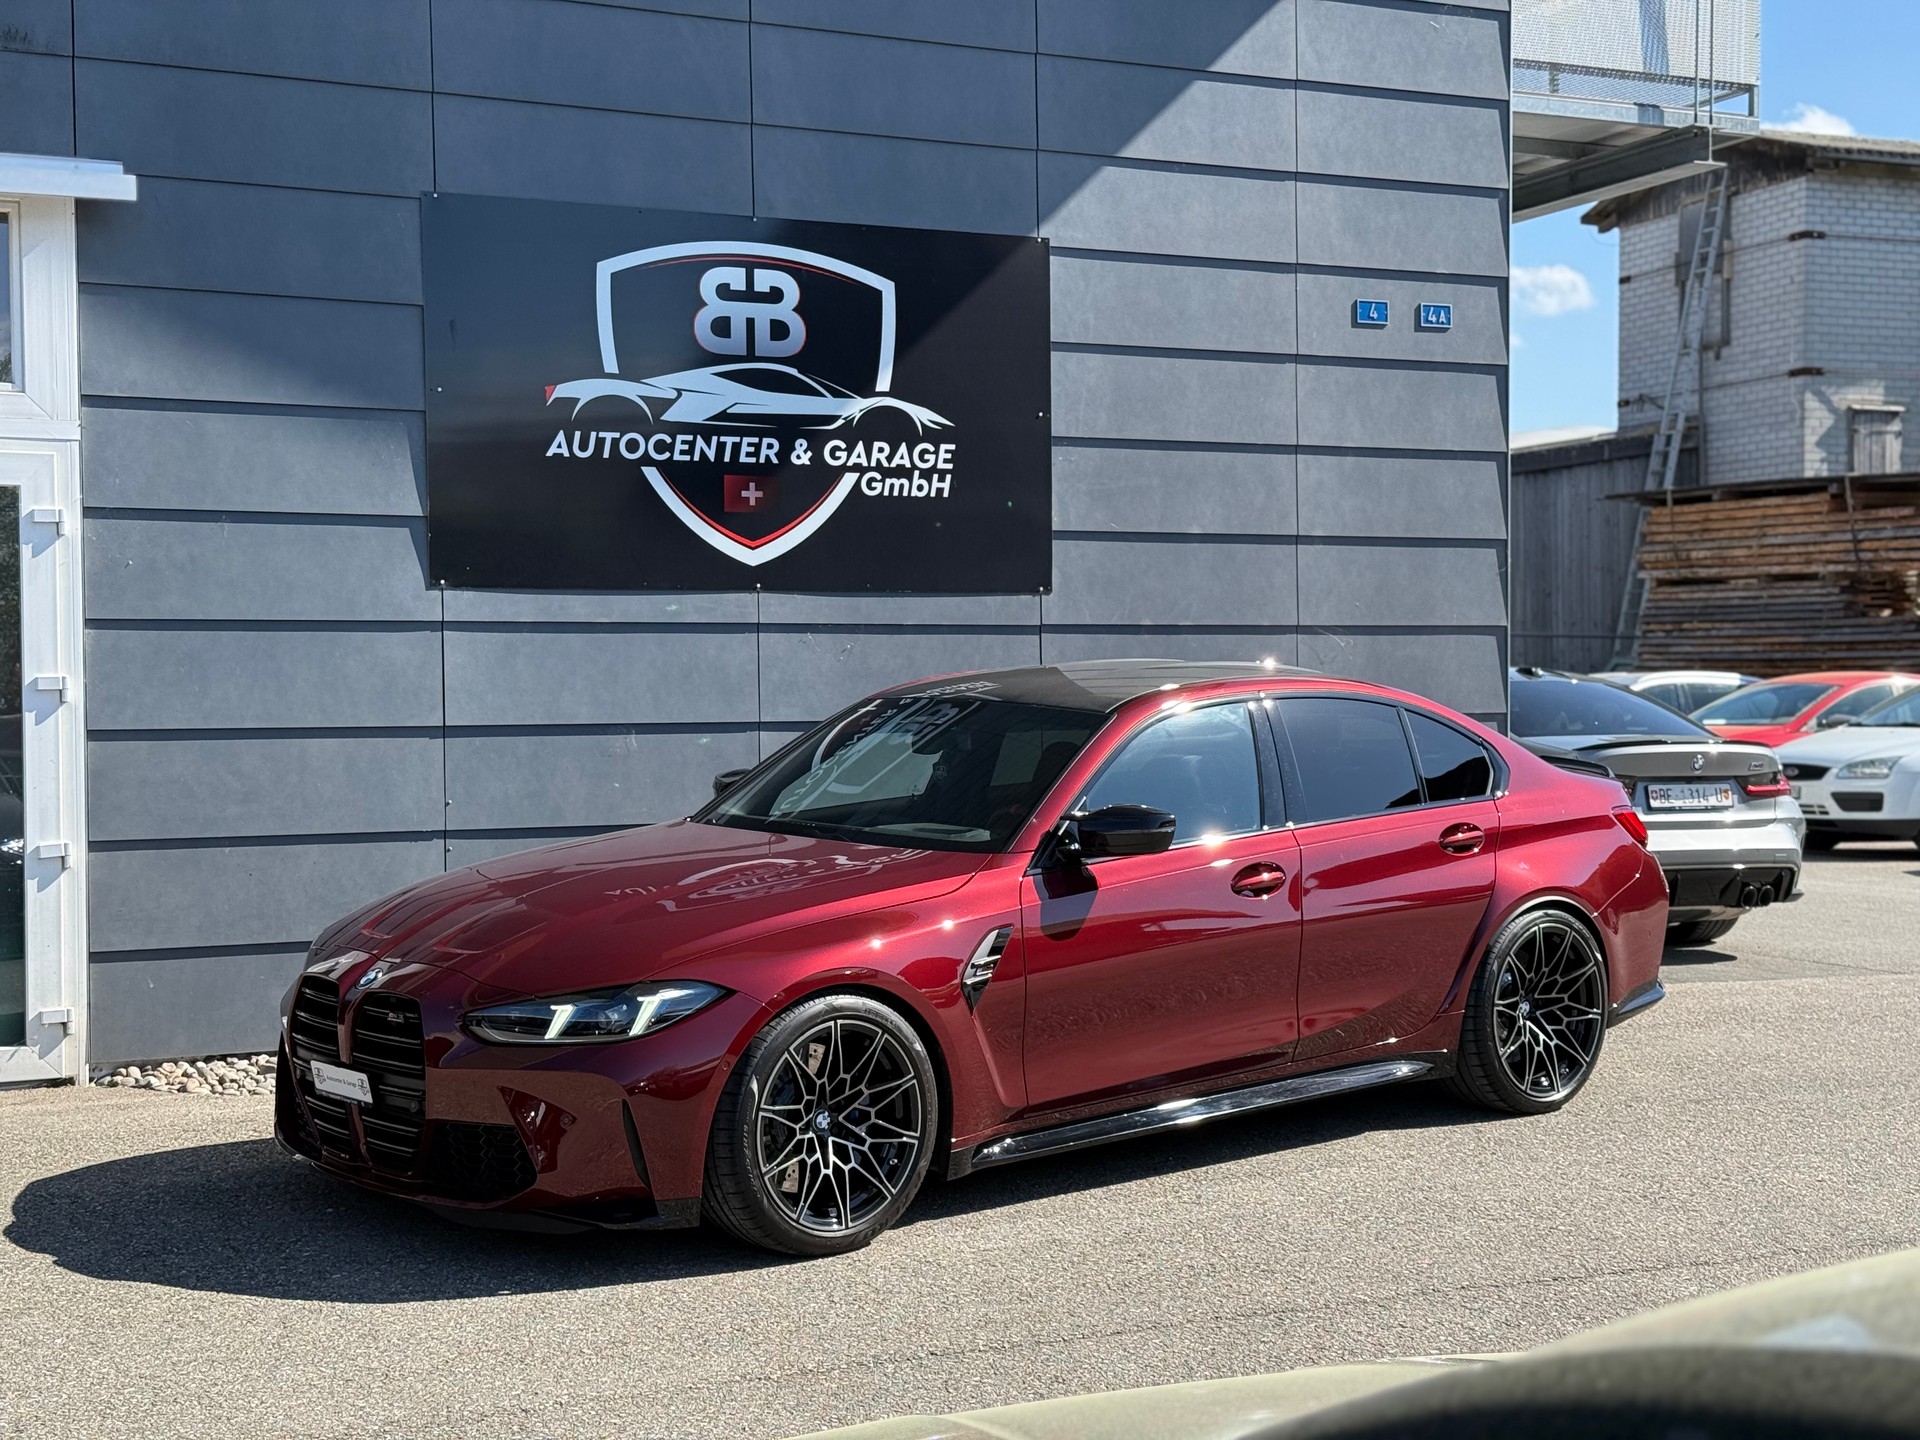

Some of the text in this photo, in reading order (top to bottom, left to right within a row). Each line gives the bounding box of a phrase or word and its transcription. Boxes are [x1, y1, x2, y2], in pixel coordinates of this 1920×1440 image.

[1369, 303, 1378, 319] 4
[1428, 306, 1447, 323] 4A
[546, 430, 956, 469] AUTOCENTER & GARAGE
[860, 471, 951, 498] GmbH
[1658, 788, 1674, 804] BE
[1715, 787, 1723, 803] U
